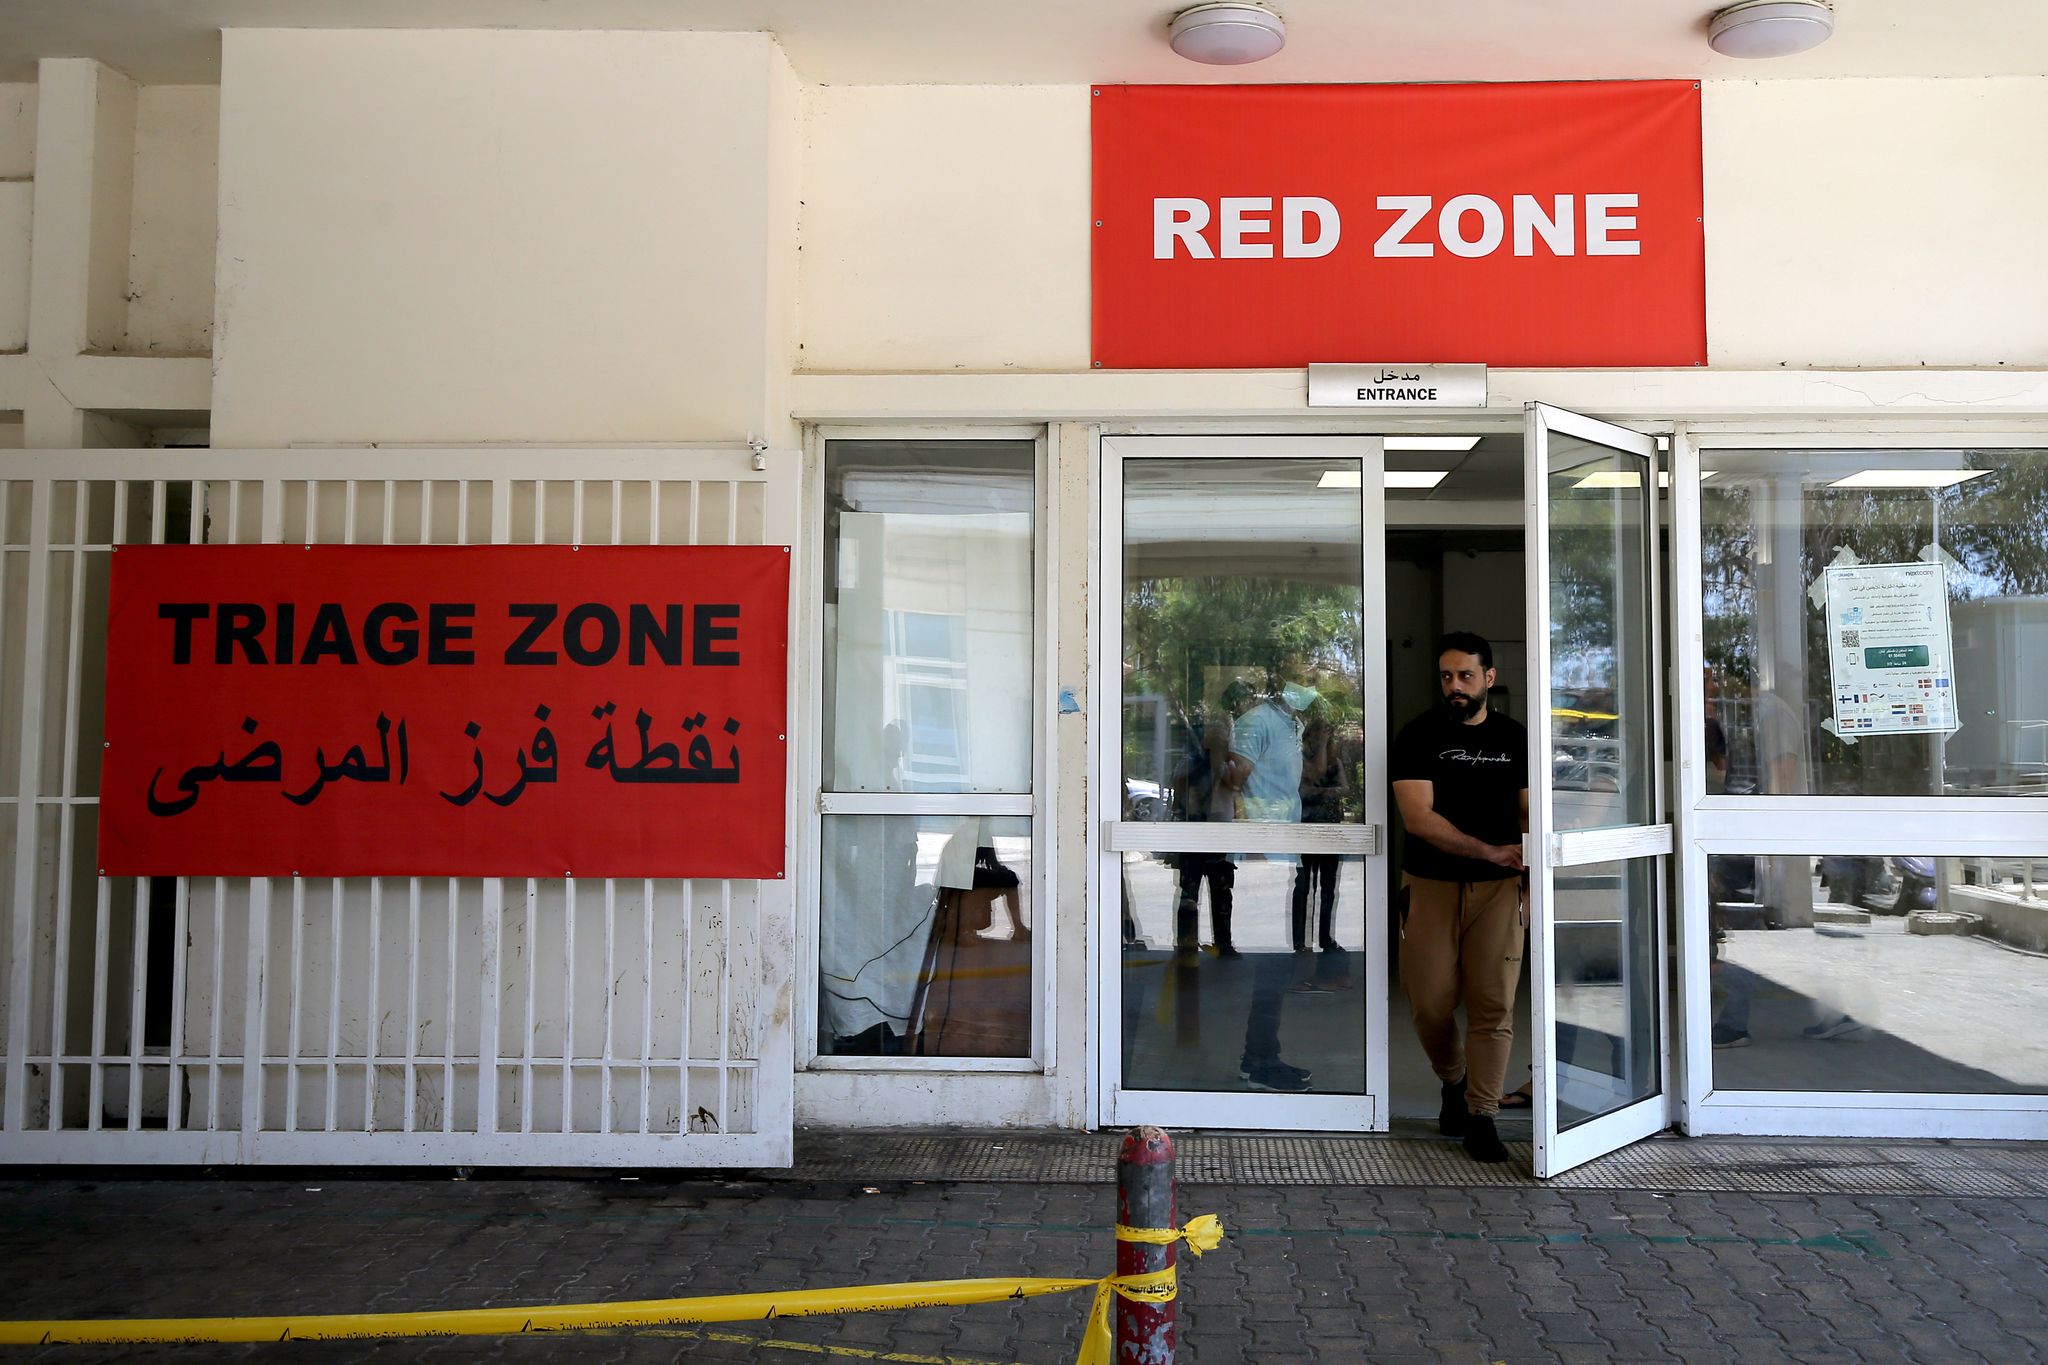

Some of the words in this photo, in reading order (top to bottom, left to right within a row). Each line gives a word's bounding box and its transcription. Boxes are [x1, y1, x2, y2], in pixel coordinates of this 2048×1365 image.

[1153, 196, 1341, 259] RED
[1373, 193, 1641, 258] ZONE
[1357, 388, 1437, 401] ENTRANCE
[1373, 369, 1421, 385] مدخل
[156, 601, 476, 667] TRIAGE
[503, 602, 741, 667] ZONE
[145, 711, 409, 819] المرضى
[439, 703, 558, 808] فرز
[585, 701, 741, 784] نقطة
